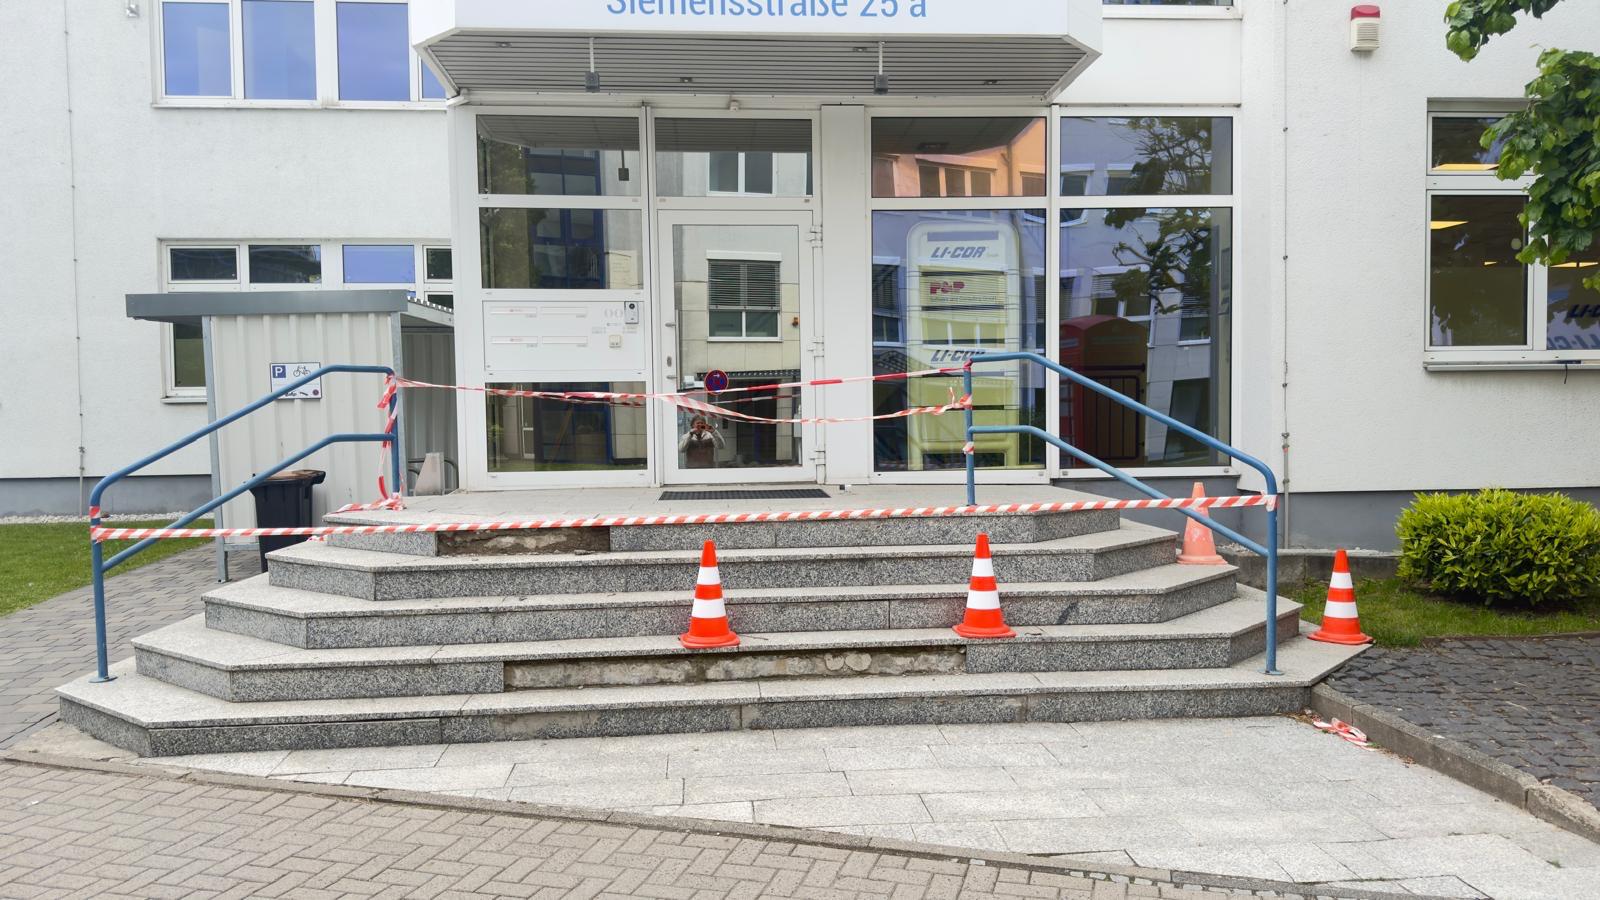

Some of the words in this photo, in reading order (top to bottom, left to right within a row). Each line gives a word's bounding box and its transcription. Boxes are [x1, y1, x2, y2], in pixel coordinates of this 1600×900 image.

[860, 0, 898, 17] 25
[910, 0, 926, 17] a
[931, 349, 985, 362] LI-CO
[275, 366, 283, 377] P
